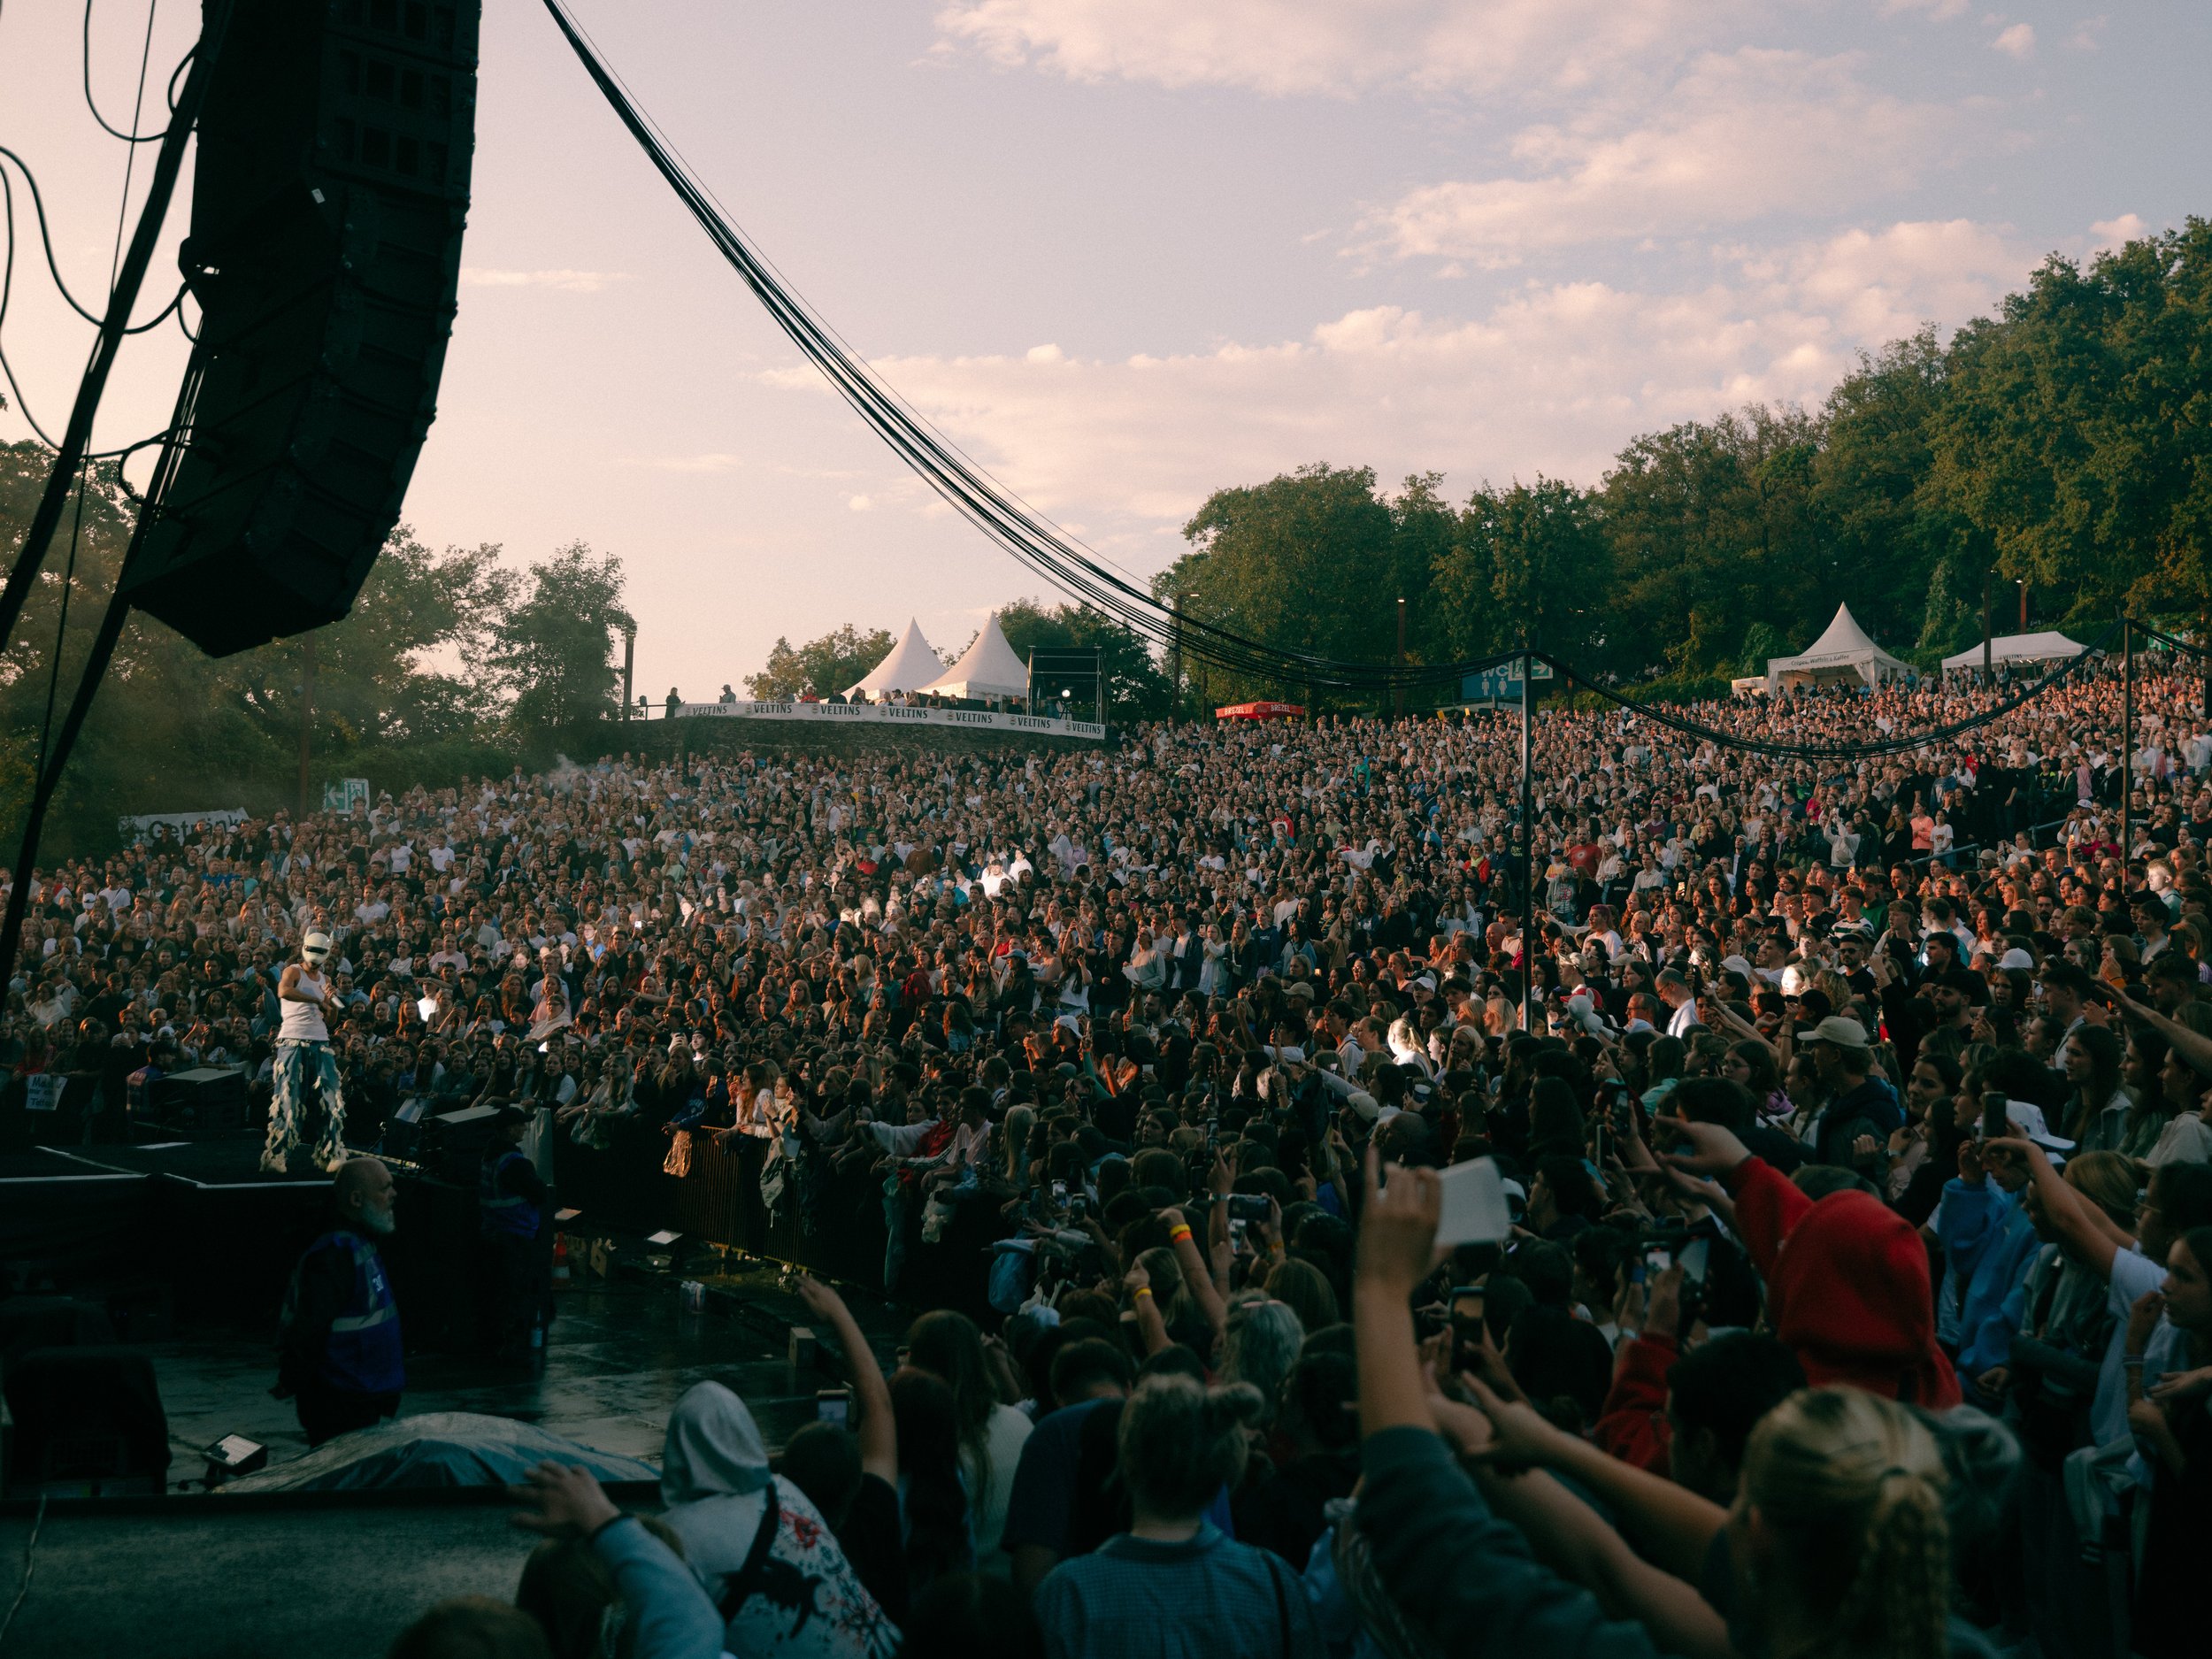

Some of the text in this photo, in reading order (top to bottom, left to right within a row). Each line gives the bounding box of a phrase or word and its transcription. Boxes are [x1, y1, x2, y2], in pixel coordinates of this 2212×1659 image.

[1480, 664, 1509, 679] WC
[692, 705, 728, 716] VELTINS
[753, 703, 793, 714] VELTINS
[820, 705, 861, 716] VELTINS
[888, 707, 929, 719] VELTINS
[1224, 706, 1245, 716] BREZEL
[955, 711, 994, 724] VELTINS
[1017, 717, 1052, 729] VELTINS
[1071, 722, 1102, 734] VELTINS
